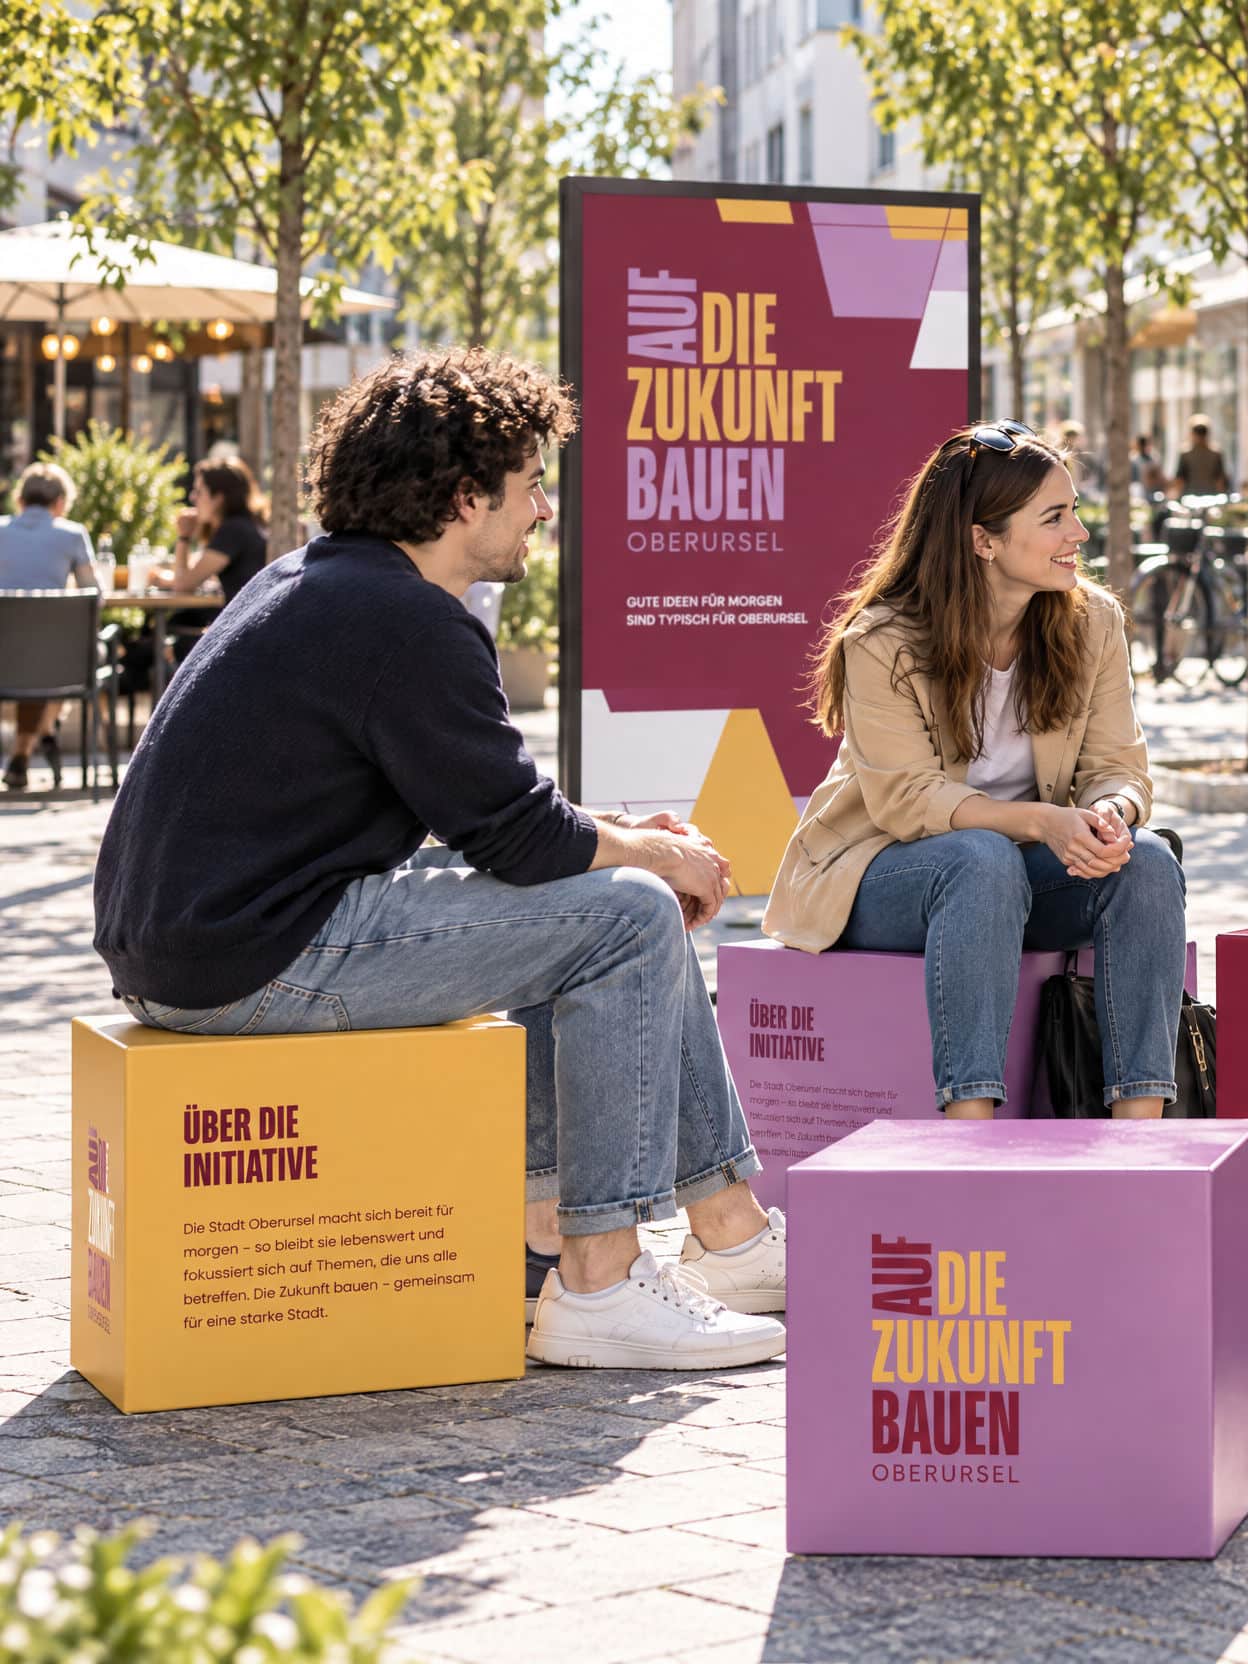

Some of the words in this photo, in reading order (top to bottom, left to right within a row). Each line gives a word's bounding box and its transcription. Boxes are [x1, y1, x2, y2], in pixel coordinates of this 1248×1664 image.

[627, 268, 697, 364] AUF
[702, 292, 777, 366] DIE
[627, 367, 843, 442] ZUKUNFT
[627, 447, 785, 521] BAUEN
[627, 532, 784, 552] OBERURSEL
[626, 596, 660, 608] GUTE
[663, 595, 698, 607] IDEEN
[701, 593, 725, 607] FÜR
[728, 595, 783, 607] MORGEN
[626, 614, 656, 626] SIND
[658, 613, 710, 625] TYPISCH
[712, 611, 736, 625] FÜR
[738, 612, 808, 625] OBERURSEL
[750, 998, 787, 1029] ÜBER
[791, 1006, 814, 1031] DIE
[750, 1033, 825, 1062] INITIATIVE
[183, 1104, 251, 1145] ÜBER
[259, 1104, 299, 1140] DIE
[183, 1145, 318, 1188] INITIATIVE
[184, 1223, 205, 1235] Die
[208, 1219, 246, 1234] Stadt
[248, 1215, 314, 1231] Oberursel
[318, 1211, 362, 1225] macht
[364, 1208, 392, 1222] sich
[395, 1206, 433, 1220] bereit
[435, 1204, 454, 1217] für
[184, 1245, 239, 1260] morgen
[254, 1242, 271, 1253] so
[275, 1238, 314, 1252] bleibt
[317, 1236, 337, 1249] sie
[340, 1230, 415, 1247] lebenswert
[418, 1227, 444, 1241] und
[184, 1267, 254, 1282] fokussiert
[257, 1263, 286, 1277] sich
[289, 1260, 313, 1274] auf
[316, 1256, 376, 1272] Themen,
[380, 1254, 402, 1267] die
[405, 1252, 430, 1264] uns
[433, 1250, 457, 1263] alle
[872, 1233, 932, 1316] AUF
[938, 1250, 1007, 1316] DIE
[184, 1291, 250, 1306] betreffen.
[254, 1288, 276, 1300] Die
[279, 1283, 330, 1298] Zukunft
[333, 1279, 378, 1293] bauen
[393, 1271, 475, 1292] gemeinsam
[184, 1317, 203, 1330] für
[206, 1313, 237, 1327] eine
[240, 1310, 284, 1325] starke
[287, 1306, 329, 1321] Stadt.
[872, 1319, 1072, 1385] ZUKUNFT
[872, 1389, 1020, 1456] BAUEN
[872, 1463, 1020, 1483] OBERURSEL
